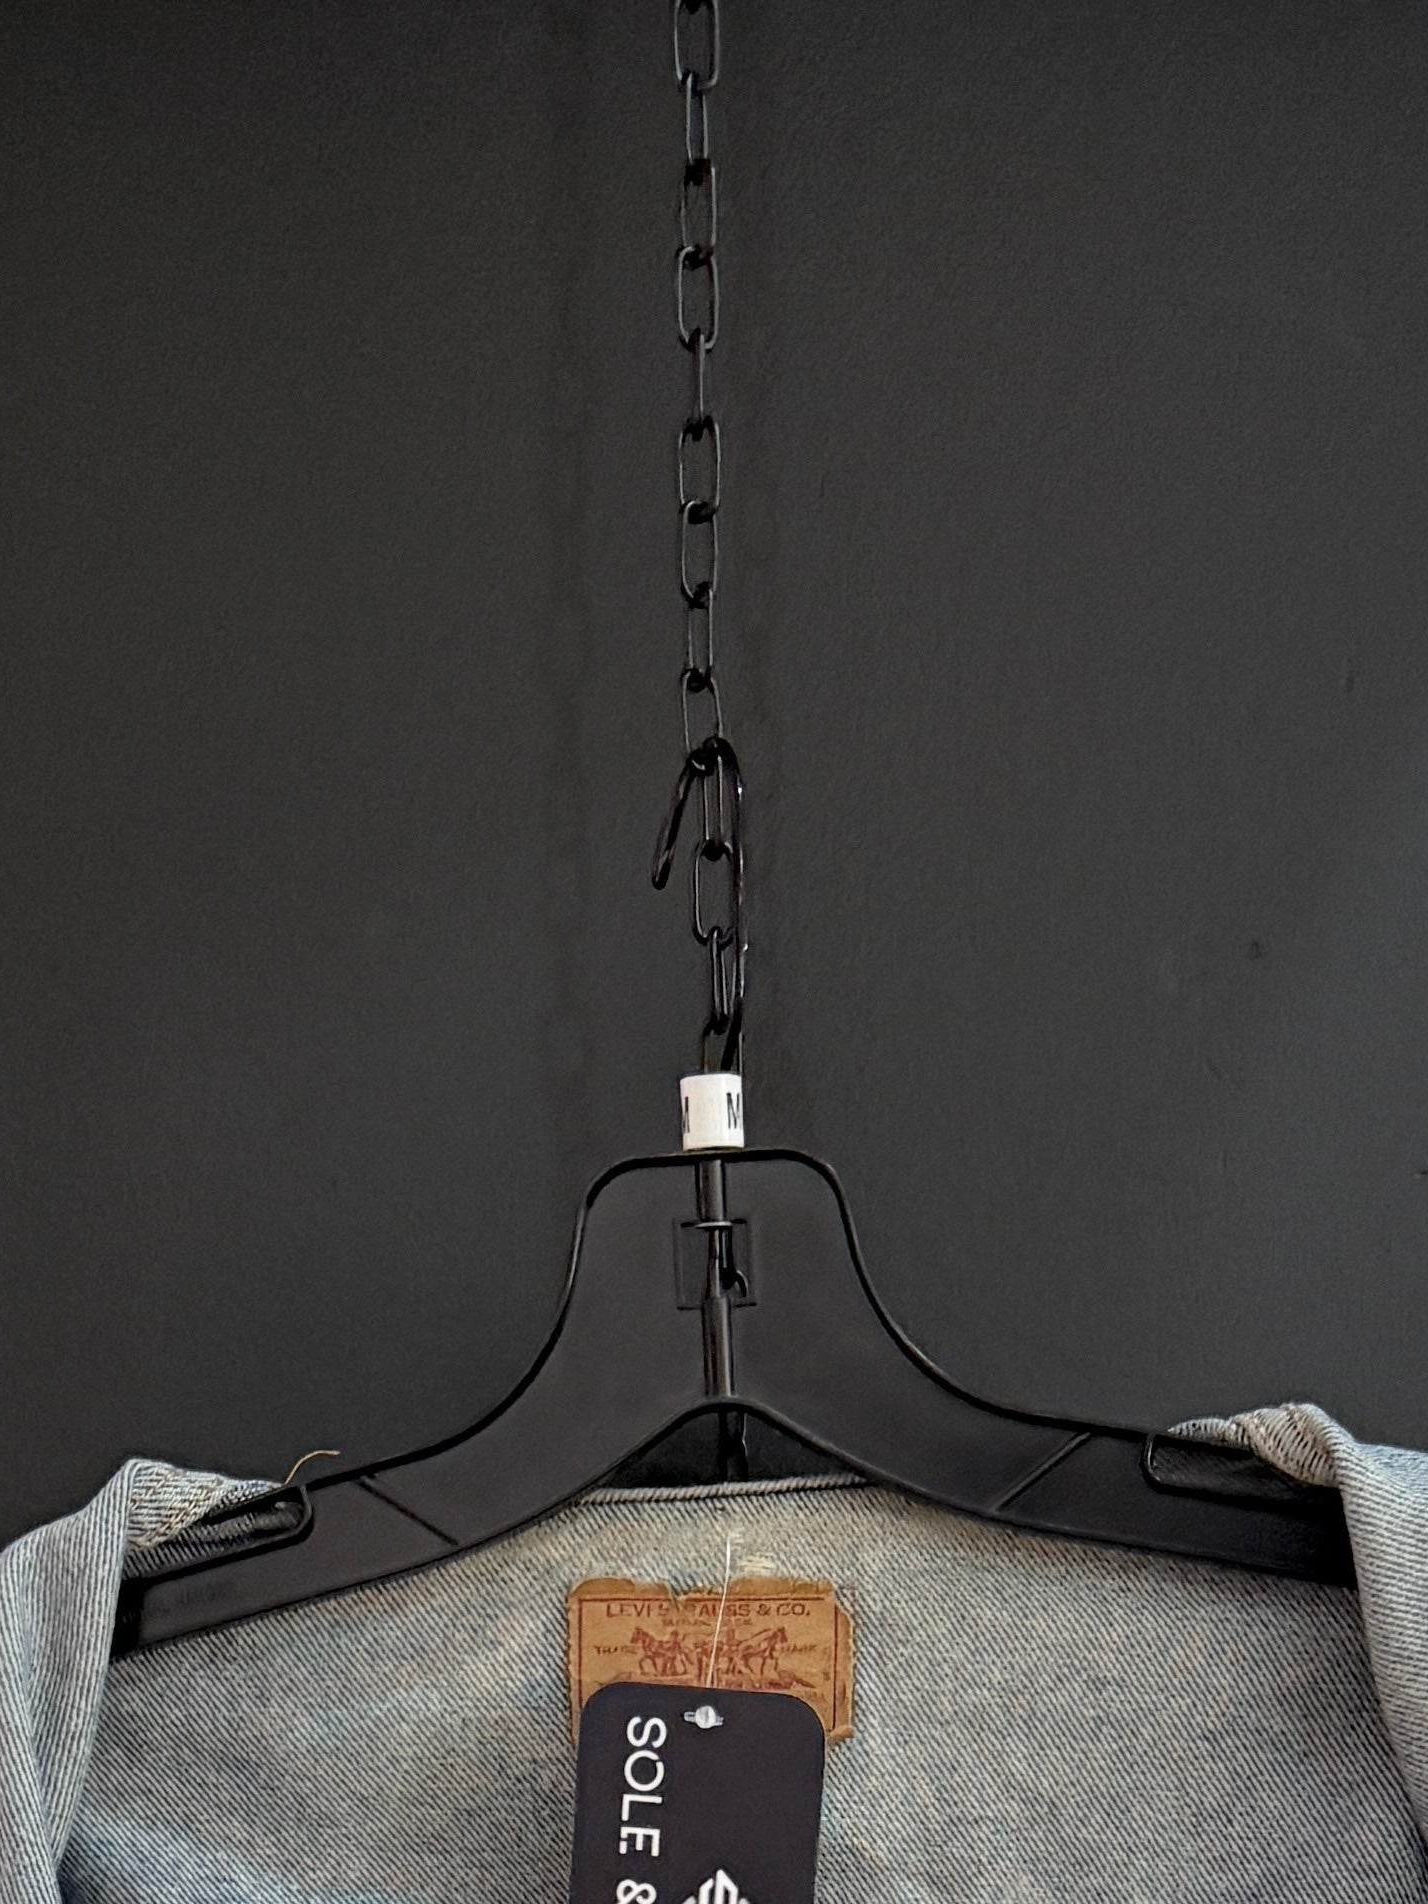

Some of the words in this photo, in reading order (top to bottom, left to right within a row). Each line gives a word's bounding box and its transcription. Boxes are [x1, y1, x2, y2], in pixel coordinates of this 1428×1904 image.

[606, 1602, 651, 1618] LEVI
[658, 1602, 751, 1618] SRASS
[756, 1602, 772, 1617] &
[619, 1715, 668, 1857] SOLE
